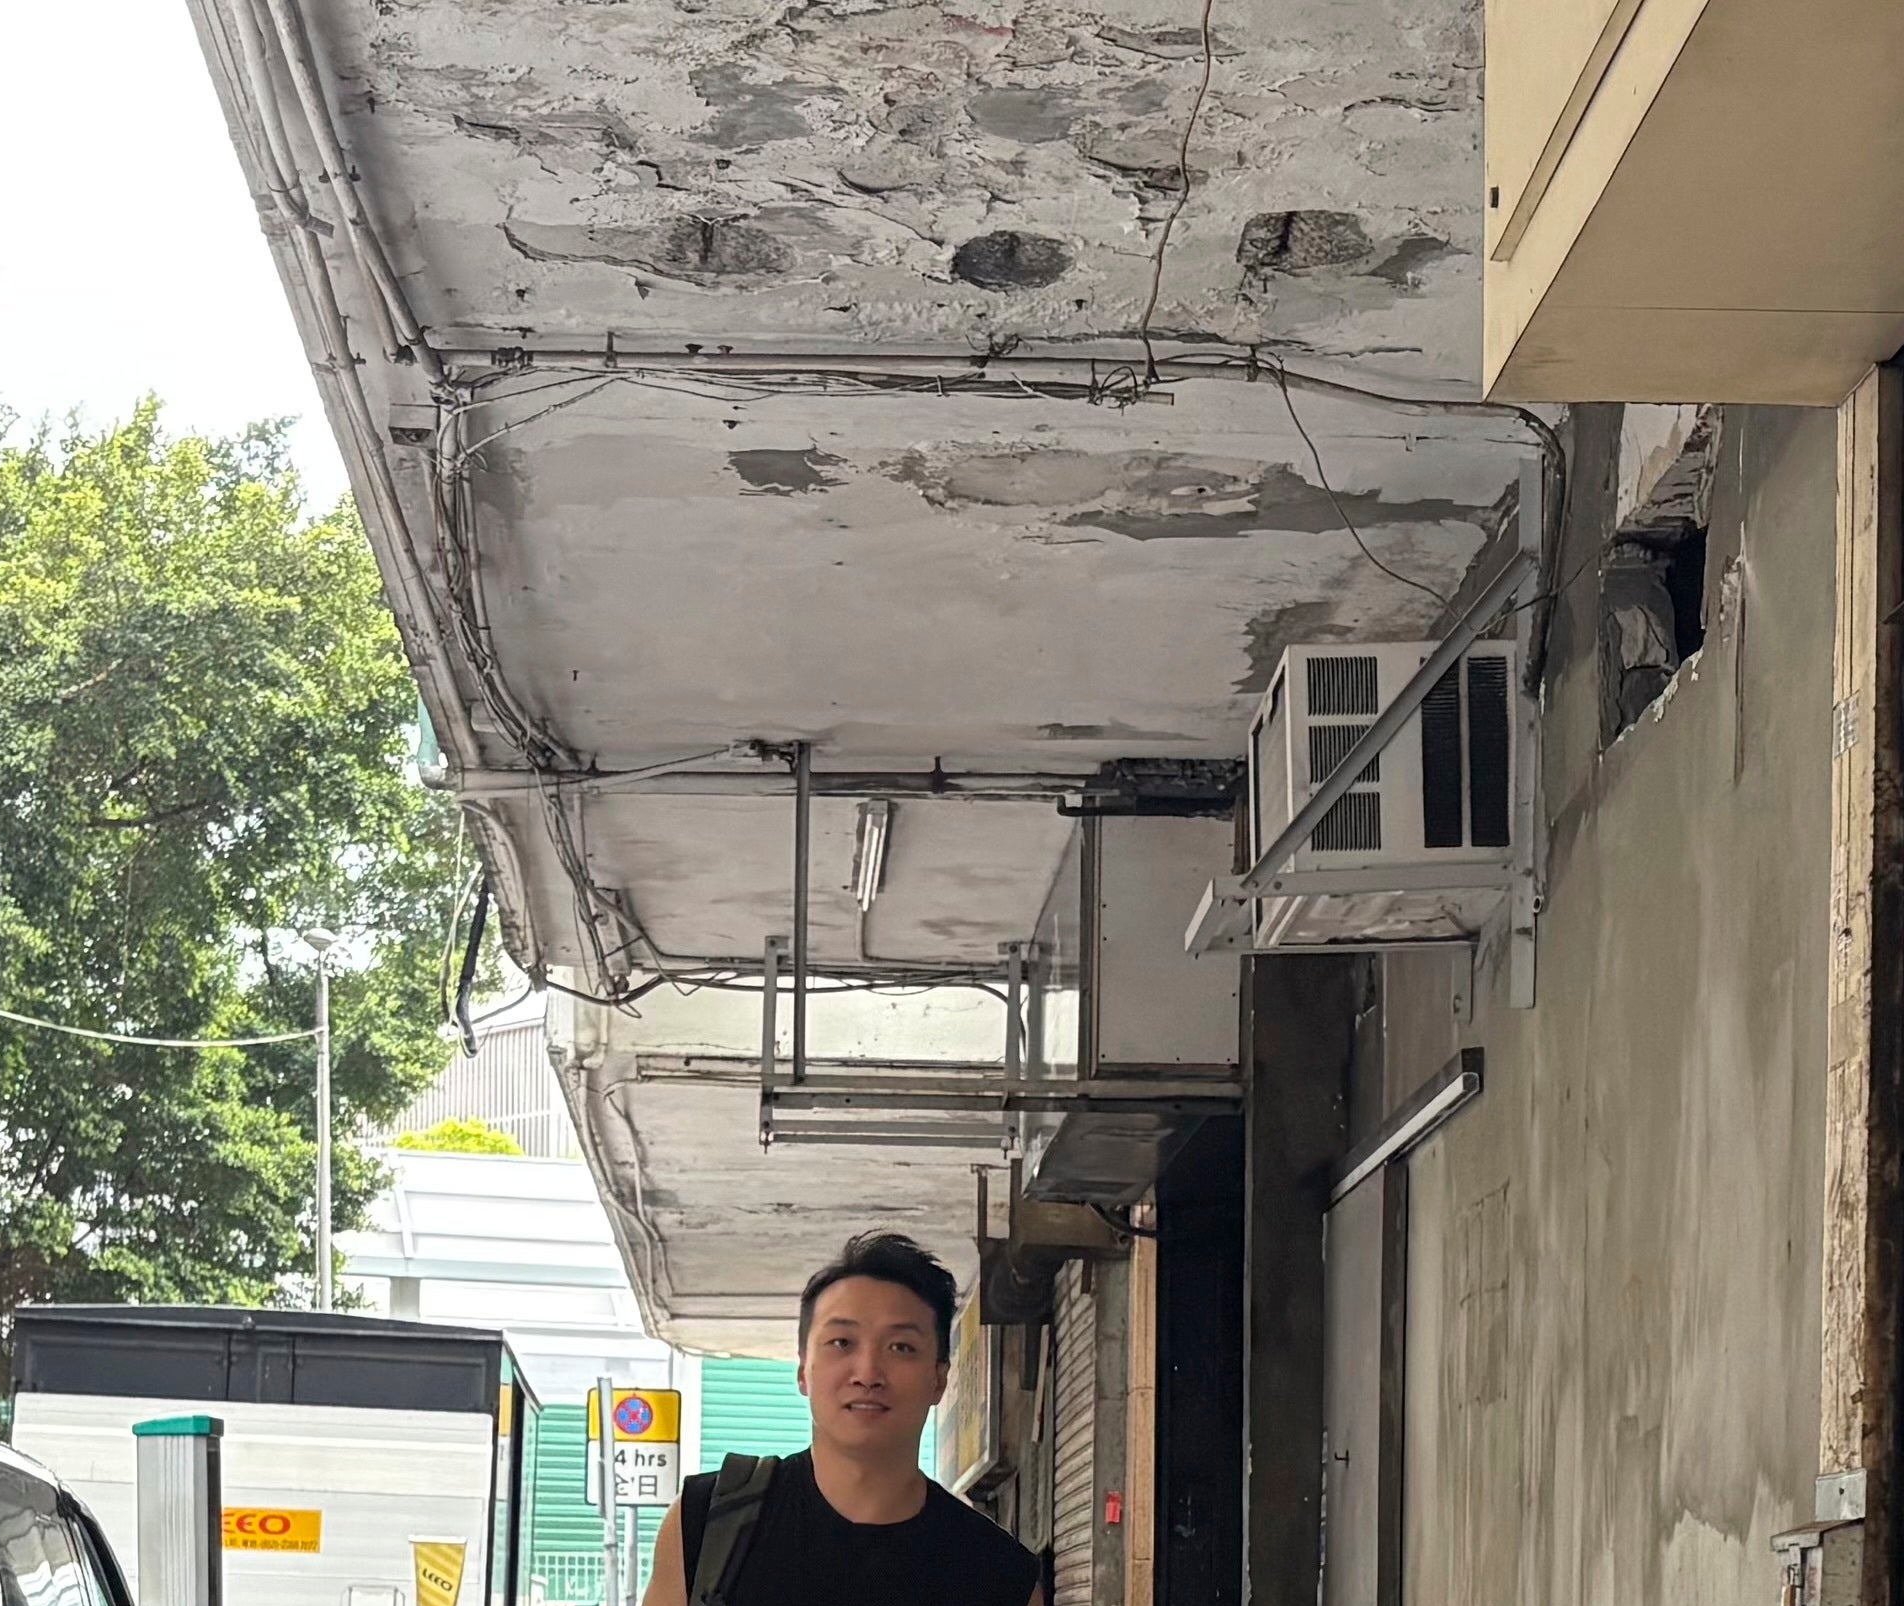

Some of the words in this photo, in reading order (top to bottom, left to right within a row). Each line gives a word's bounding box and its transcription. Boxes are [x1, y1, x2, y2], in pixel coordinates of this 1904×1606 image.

[615, 1449, 626, 1465] 4
[634, 1448, 668, 1467] hrs
[222, 1513, 291, 1535] EEO
